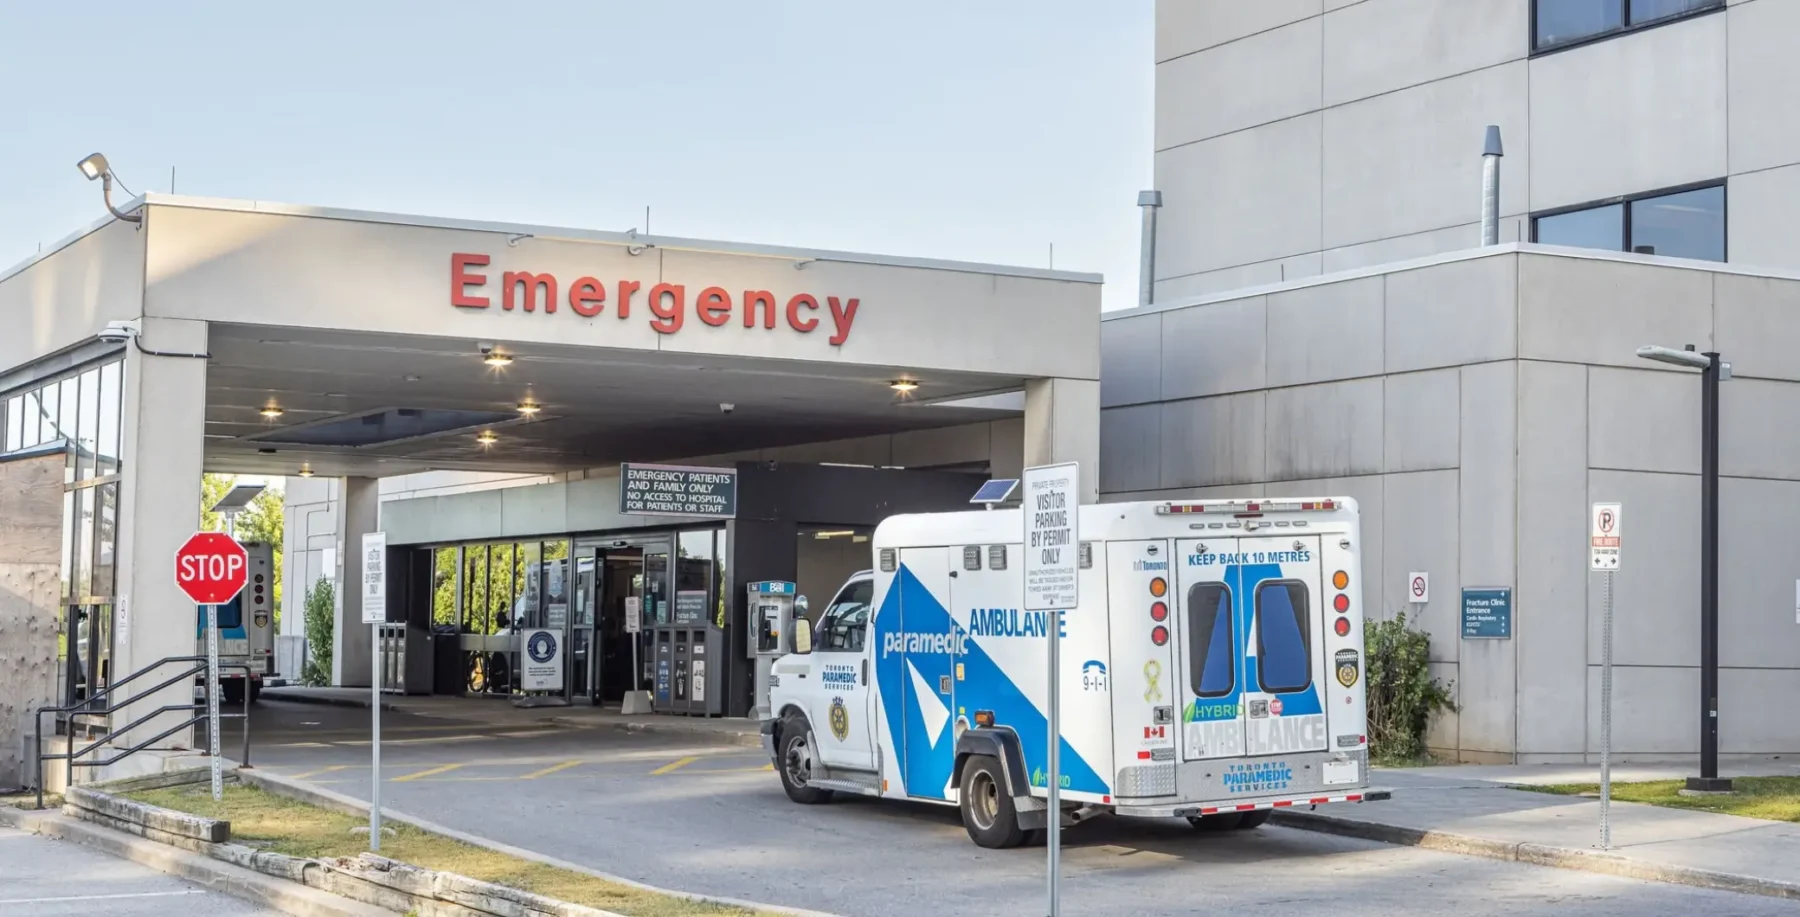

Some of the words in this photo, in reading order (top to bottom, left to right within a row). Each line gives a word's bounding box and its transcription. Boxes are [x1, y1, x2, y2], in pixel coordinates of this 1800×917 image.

[451, 253, 860, 345] Emergency
[628, 470, 685, 482] EMERGENCY
[689, 474, 730, 484] PATIENTS
[628, 481, 650, 490] AND
[654, 482, 686, 492] FAMILY
[689, 484, 714, 493] ONLY
[627, 492, 640, 500] NO
[644, 492, 673, 501] ACCESS
[676, 494, 686, 502] TO
[689, 494, 727, 504] HOSPITAL
[1037, 492, 1066, 510] VISITOR
[627, 501, 643, 510] FOR
[647, 502, 682, 511] PATIENTS
[685, 504, 697, 512] OR
[700, 504, 723, 512] STAFF
[1036, 510, 1067, 528] PARKING
[1032, 532, 1041, 547] BY
[1044, 528, 1071, 546] PERMIT
[1042, 548, 1060, 564] ONLY
[1188, 554, 1216, 566] KEEP
[1219, 552, 1248, 564] BACK
[1252, 552, 1264, 563] 10
[1268, 551, 1310, 562] METRES
[180, 554, 242, 581] STOP
[770, 582, 784, 592] Bell
[1490, 598, 1505, 606] Clinic
[969, 608, 1067, 638] AMBULANE
[883, 625, 970, 659] paramedic
[822, 672, 856, 683] PARAMEDIC
[1083, 676, 1106, 692] 9-1-1
[824, 683, 854, 691] SERVICES
[1195, 704, 1244, 718] HYBRID
[1186, 714, 1325, 757] AMBULANCE
[1230, 762, 1286, 772] TORONTO
[1223, 769, 1292, 785] PARAMEDIC
[1230, 782, 1287, 793] SERVICES
